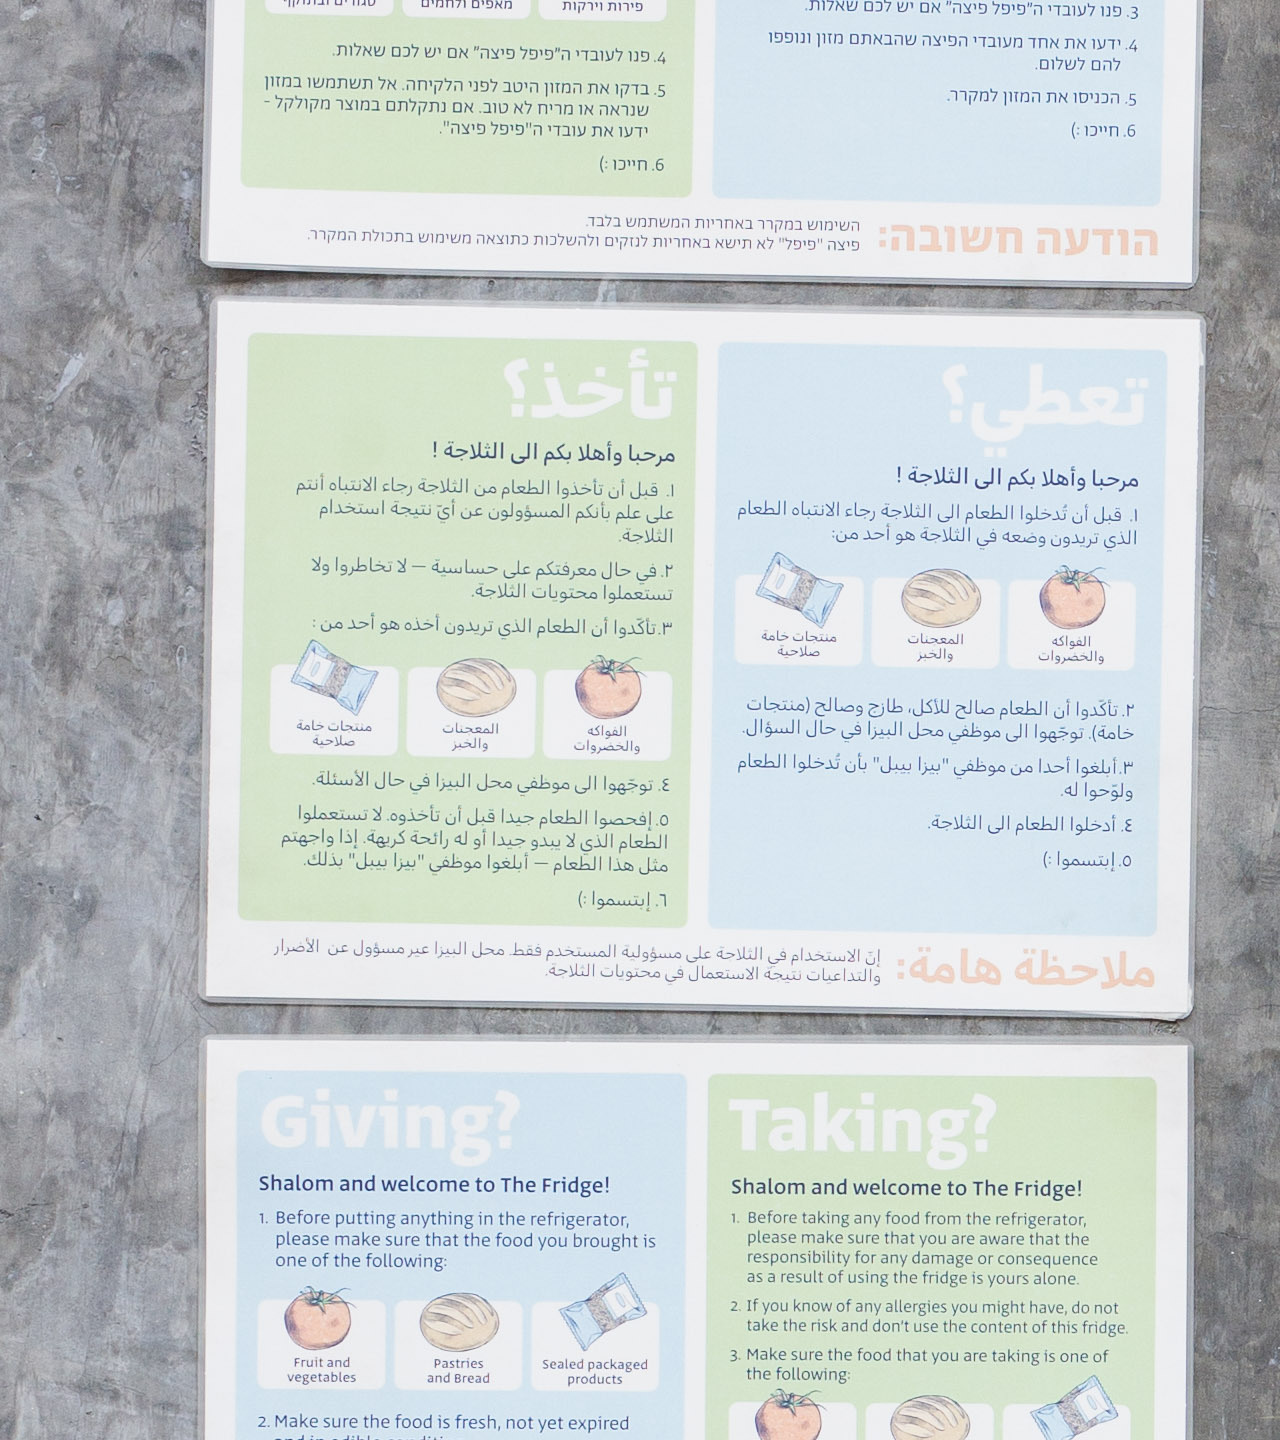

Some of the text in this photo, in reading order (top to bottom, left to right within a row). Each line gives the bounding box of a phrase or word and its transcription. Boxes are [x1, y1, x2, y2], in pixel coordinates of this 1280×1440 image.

[947, 88, 998, 106] למקרר.
[1003, 91, 1041, 106] המזון
[1046, 92, 1068, 104] את
[1073, 92, 1120, 104] הכניסו
[584, 215, 860, 233] השימוש במקרר באחריות המשתמש בלבד.
[879, 224, 1158, 256] הודעה חשובה:
[504, 347, 678, 420] تأخذ؟
[942, 363, 1149, 458] تعطي؟
[443, 441, 504, 461] الثلاجة
[510, 442, 538, 465] الى
[543, 443, 572, 467] بكم
[578, 440, 622, 467] وأهلا
[628, 444, 675, 467] مرحبا
[908, 466, 968, 487] الثلاجة
[974, 467, 1001, 490] الى
[1007, 468, 1035, 492] بكم
[1041, 466, 1086, 492] وأهلا
[1092, 469, 1139, 493] مرحبا
[907, 633, 964, 646] المعجنات
[928, 814, 982, 831] الثلاجة.
[987, 815, 1010, 835] الى
[1015, 815, 1064, 836] الطعام
[1070, 814, 1116, 836] أدخلوا
[897, 946, 1155, 990] ملاحظة هامة:
[261, 1088, 521, 1167] Giving?
[728, 1091, 998, 1170] Taking?
[259, 1174, 609, 1198] Shalom and welcome to The Fridge!
[731, 1177, 1082, 1202] Shalom and welcome to The Fridge!
[294, 1356, 350, 1368] Fruit and
[434, 1358, 484, 1369] Pastries
[543, 1358, 647, 1373] Sealed packaged
[287, 1371, 356, 1385] vegetables
[427, 1372, 490, 1384] and Bread
[567, 1374, 623, 1387] products
[275, 1413, 319, 1428] Make
[323, 1417, 358, 1429] sure
[363, 1414, 390, 1429] the
[395, 1413, 433, 1429] food
[437, 1414, 450, 1429] is
[454, 1414, 501, 1432] fresh,
[506, 1417, 534, 1430] not
[538, 1417, 564, 1434] yet
[568, 1416, 629, 1434] expired
